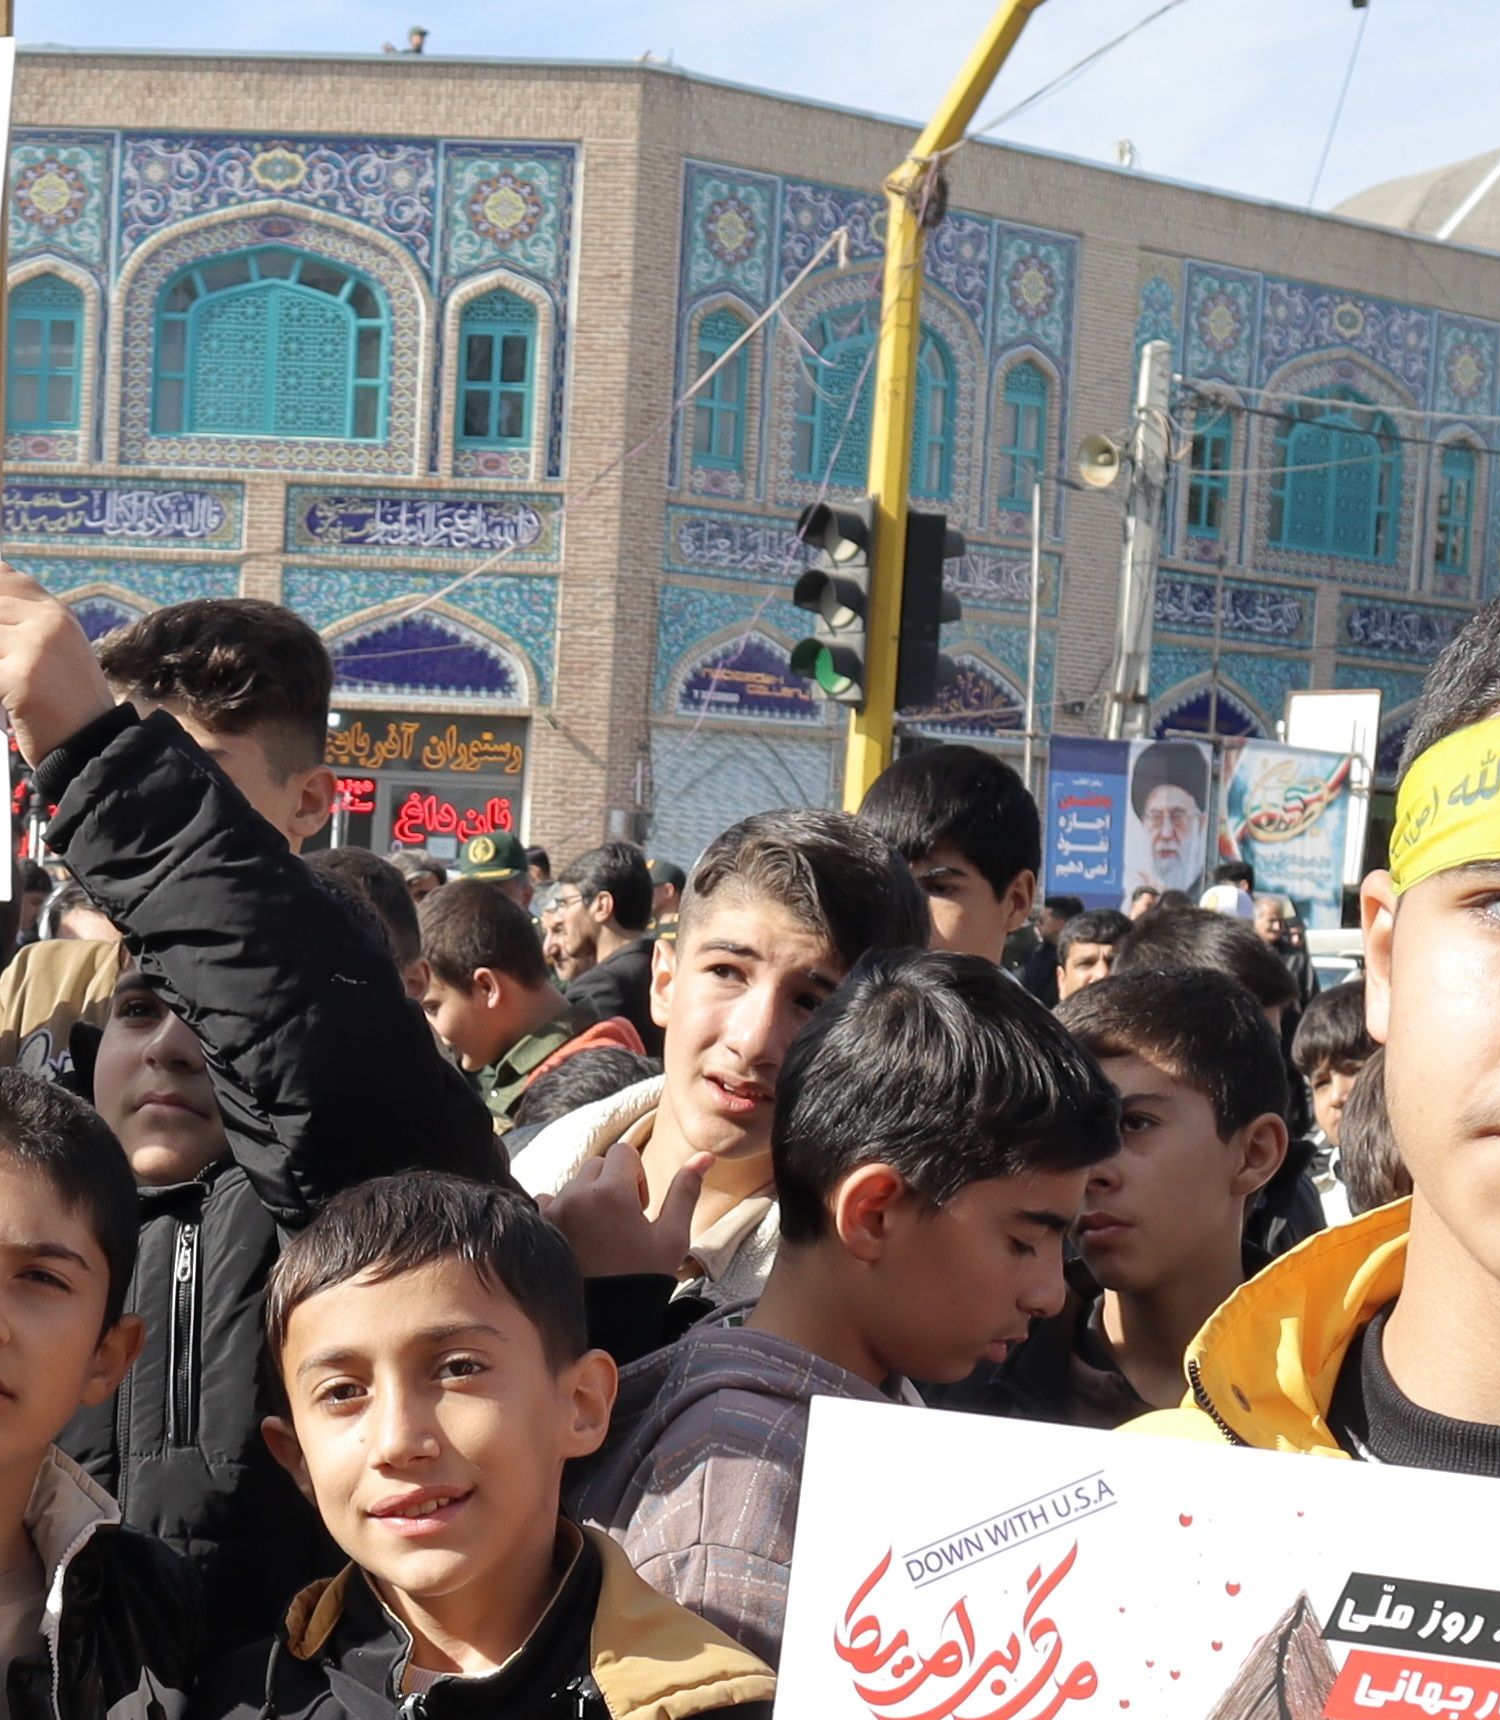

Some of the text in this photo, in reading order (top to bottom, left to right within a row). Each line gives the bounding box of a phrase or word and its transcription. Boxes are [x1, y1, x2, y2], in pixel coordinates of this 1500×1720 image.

[394, 792, 458, 844] داغ
[457, 797, 513, 844] نان
[905, 1479, 1115, 1582] DOWN WITH U.S.A
[1416, 1599, 1485, 1645] روز
[1353, 1669, 1476, 1720] جهانی
